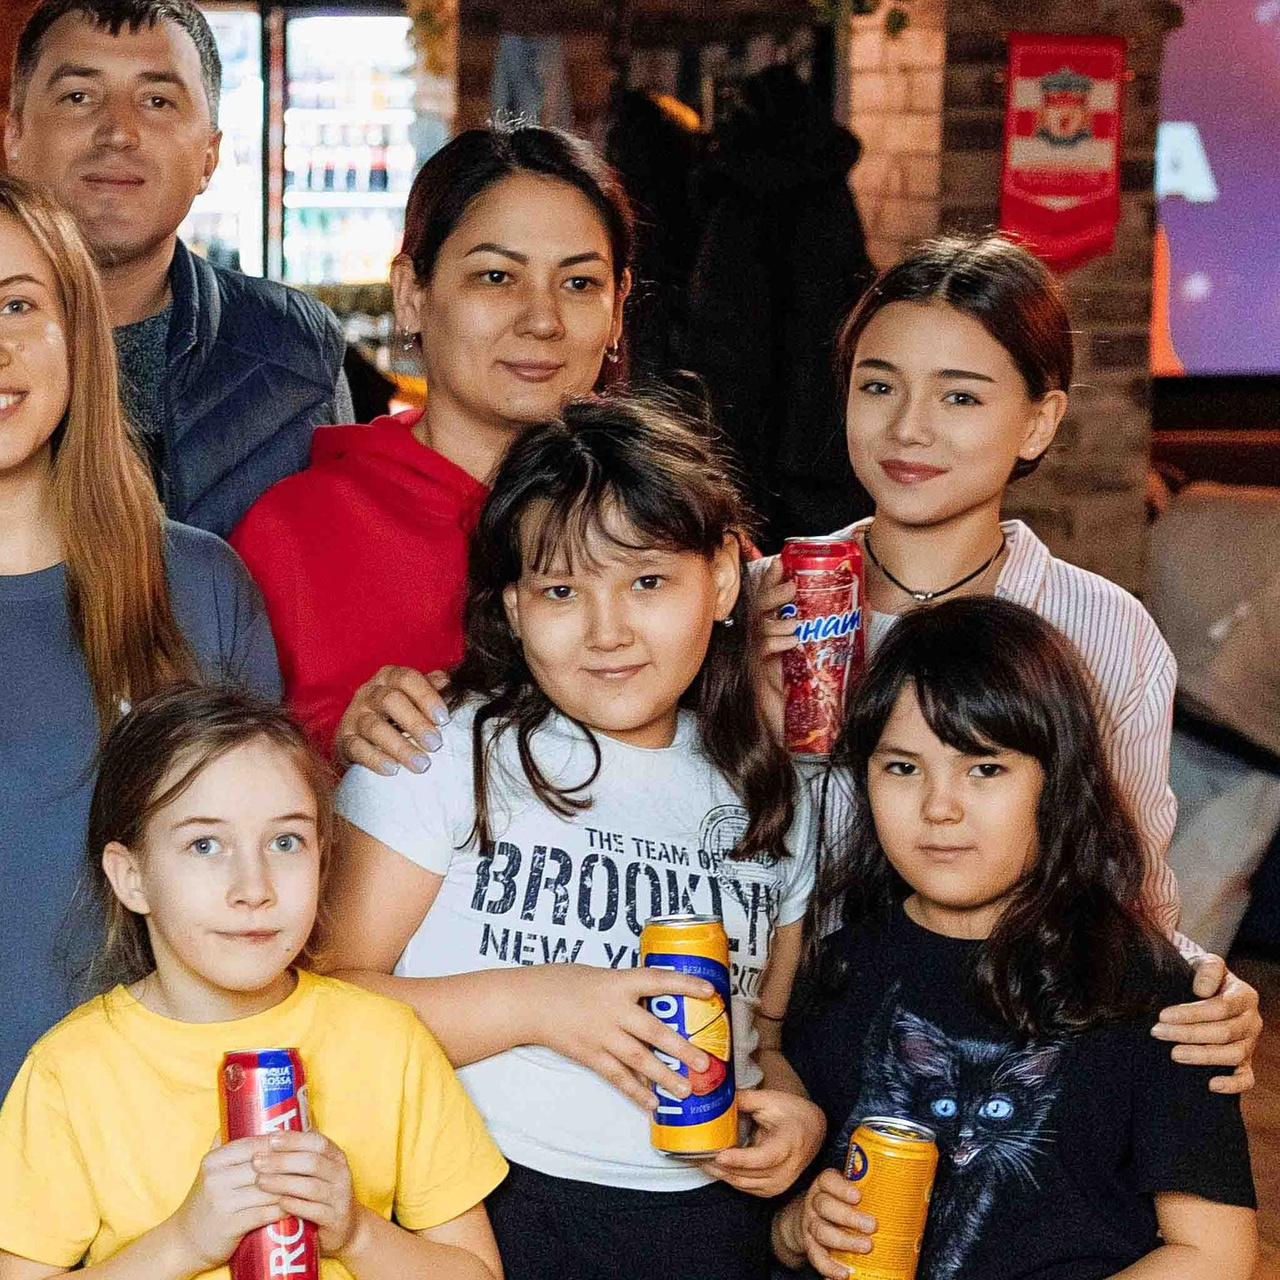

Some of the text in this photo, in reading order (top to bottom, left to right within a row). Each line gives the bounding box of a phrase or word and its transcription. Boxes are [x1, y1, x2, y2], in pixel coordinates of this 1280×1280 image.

[585, 828, 624, 854] THE
[630, 837, 689, 867] TEAM
[479, 923, 585, 966] NEW
